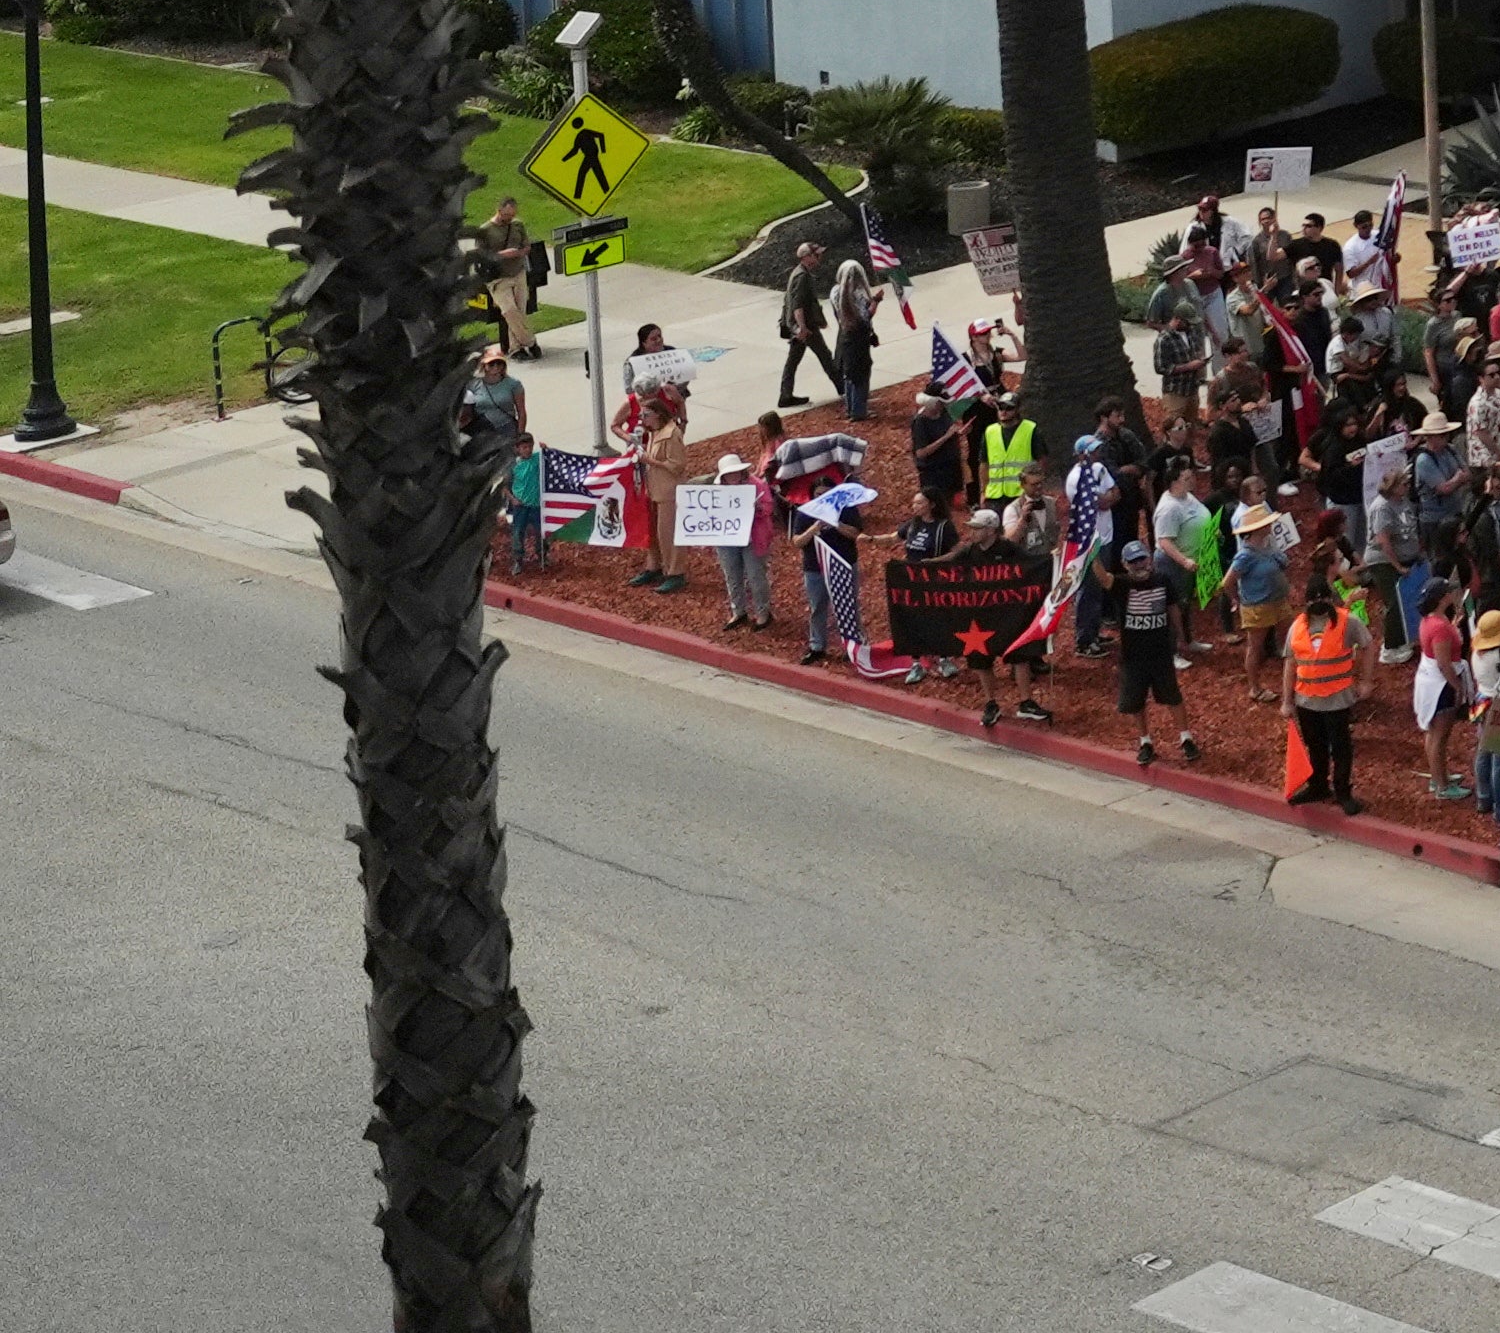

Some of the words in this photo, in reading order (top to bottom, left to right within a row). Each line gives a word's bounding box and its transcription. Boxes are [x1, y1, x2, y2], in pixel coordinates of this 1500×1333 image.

[685, 489, 723, 511] ICE
[729, 495, 741, 509] is
[682, 514, 741, 533] Gestapo
[906, 564, 930, 582] YA
[937, 568, 964, 583] SE
[971, 564, 1024, 582] MIRA
[889, 586, 921, 607] EL
[1125, 613, 1167, 630] RESIST
